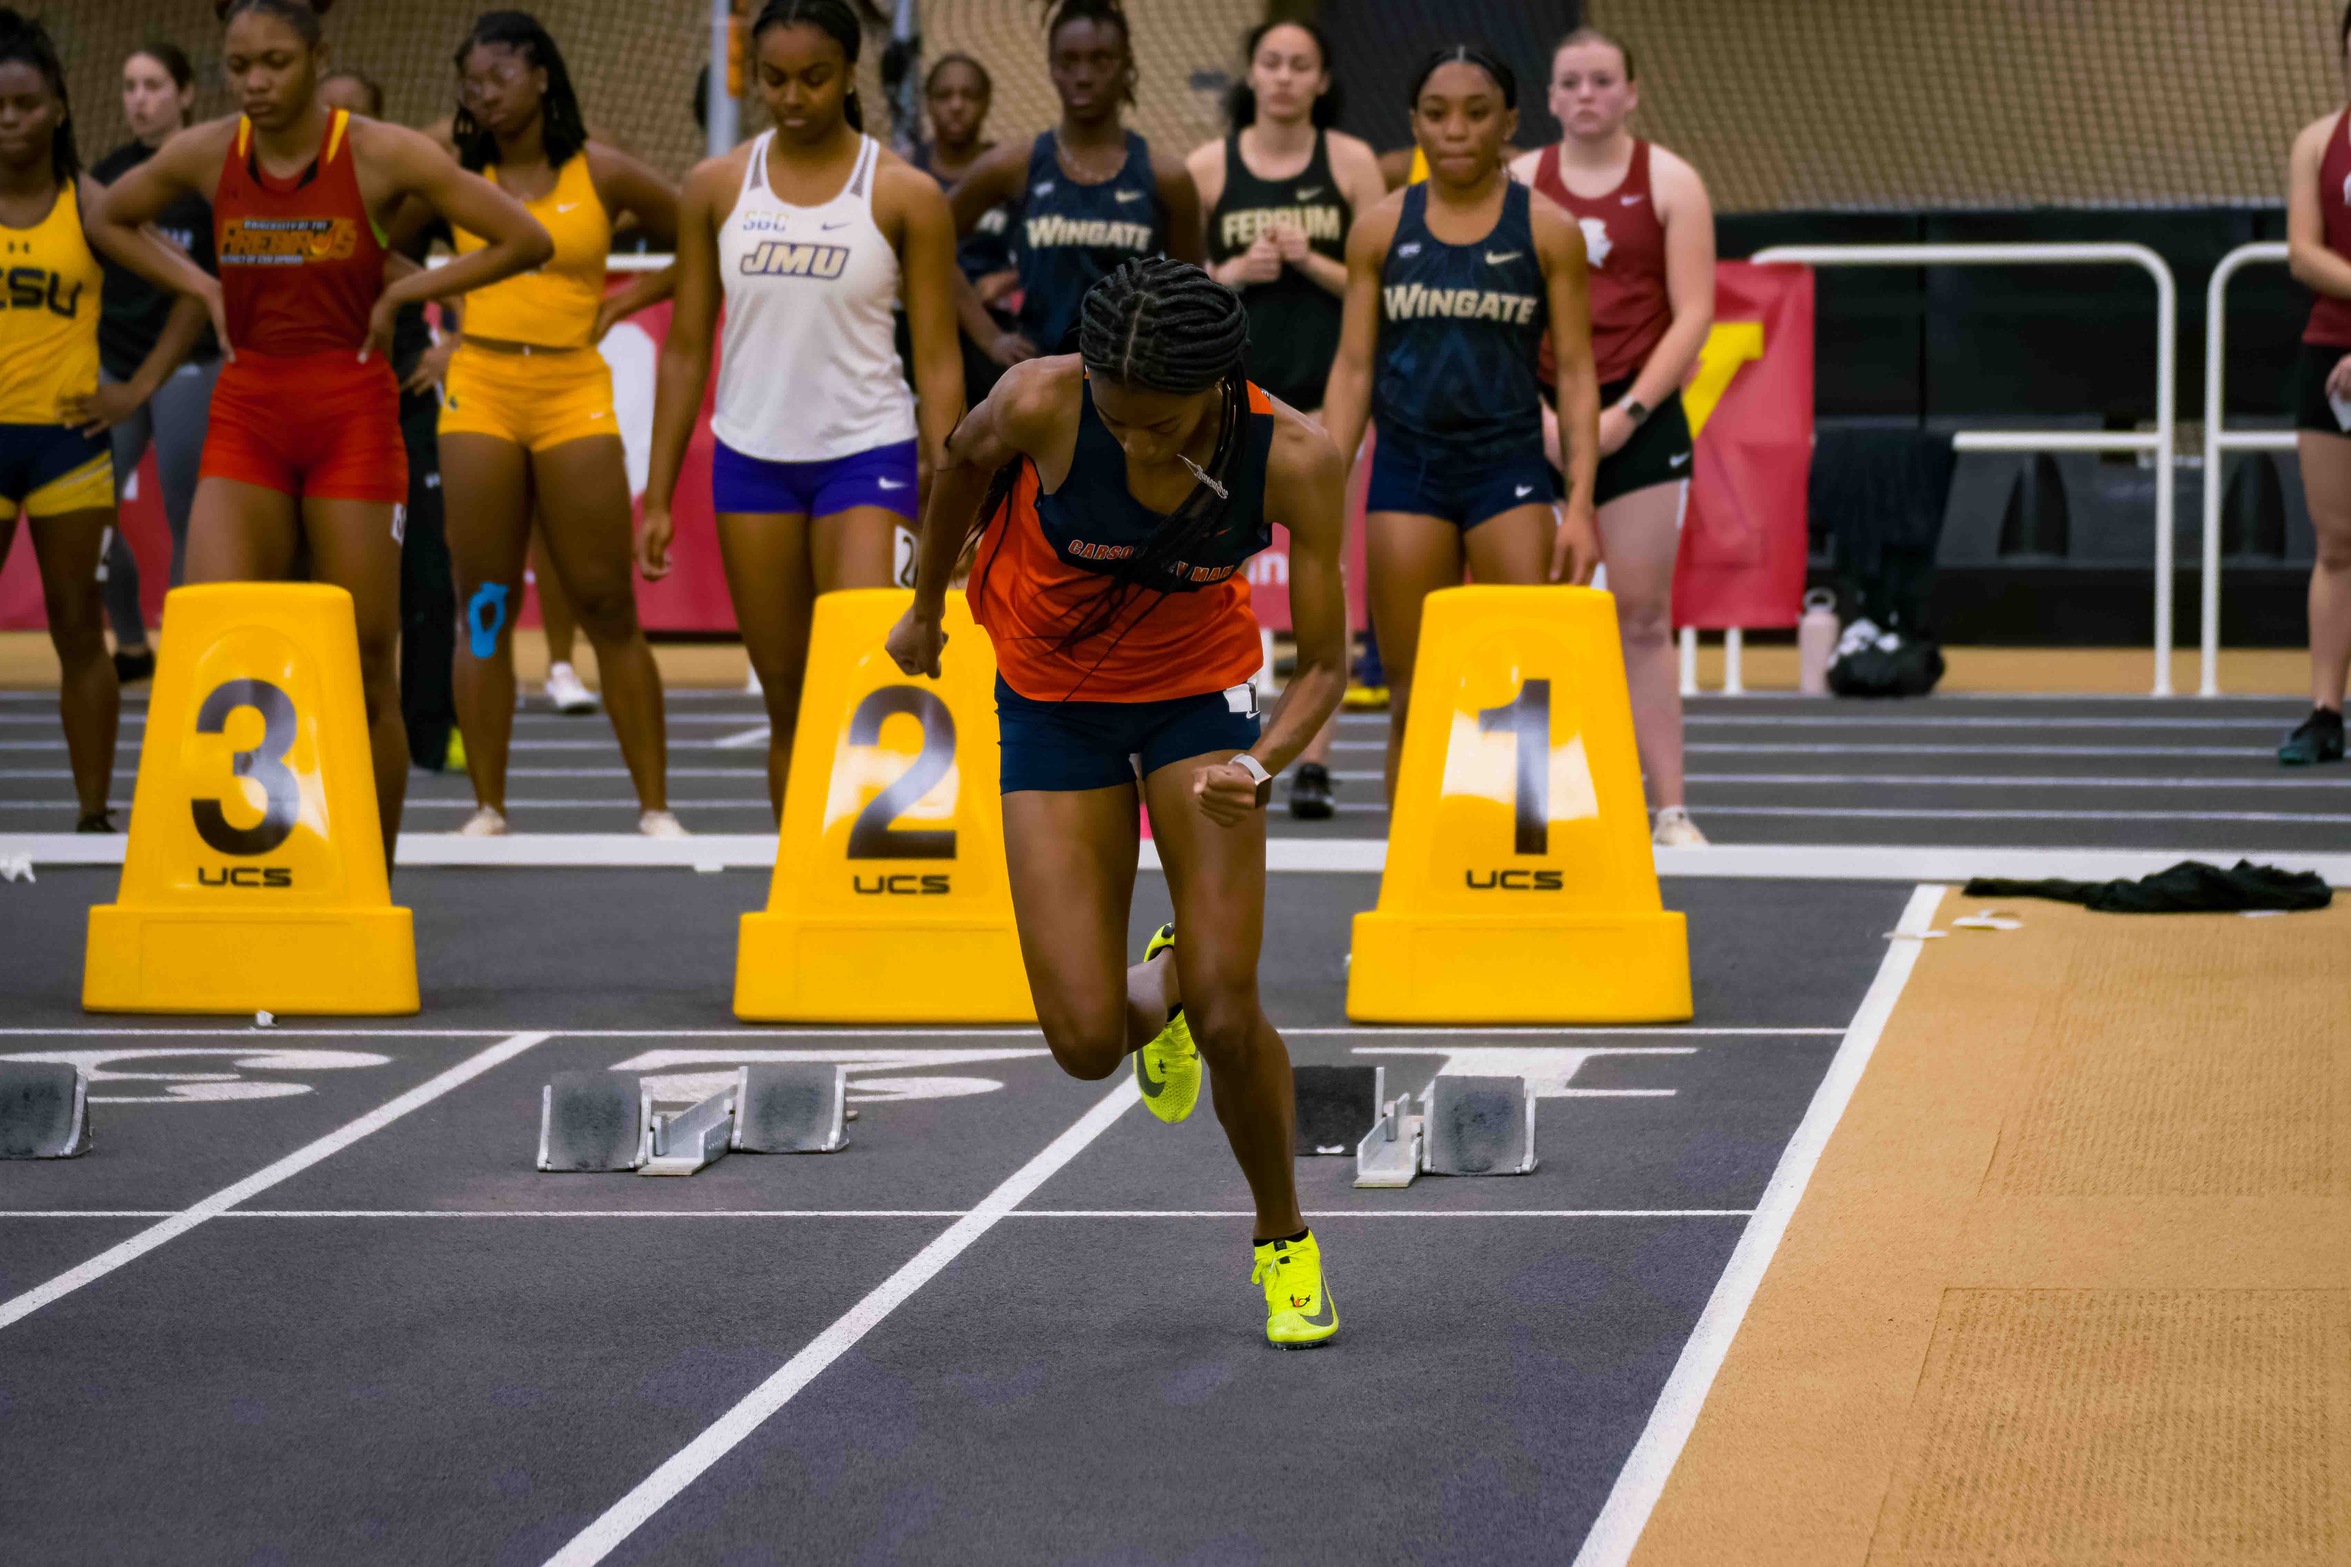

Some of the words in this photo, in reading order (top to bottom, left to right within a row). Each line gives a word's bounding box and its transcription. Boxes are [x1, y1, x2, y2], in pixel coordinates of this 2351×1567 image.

[1027, 214, 1151, 252] WINGATE
[740, 240, 850, 280] JMU
[0, 266, 83, 319] SU
[1384, 282, 1537, 324] WINGATE
[191, 678, 300, 857] 3
[847, 684, 956, 860] 2
[1478, 679, 1550, 855] 1
[198, 866, 293, 888] UCS
[854, 874, 950, 895] UCS
[1466, 869, 1564, 890] UCS
